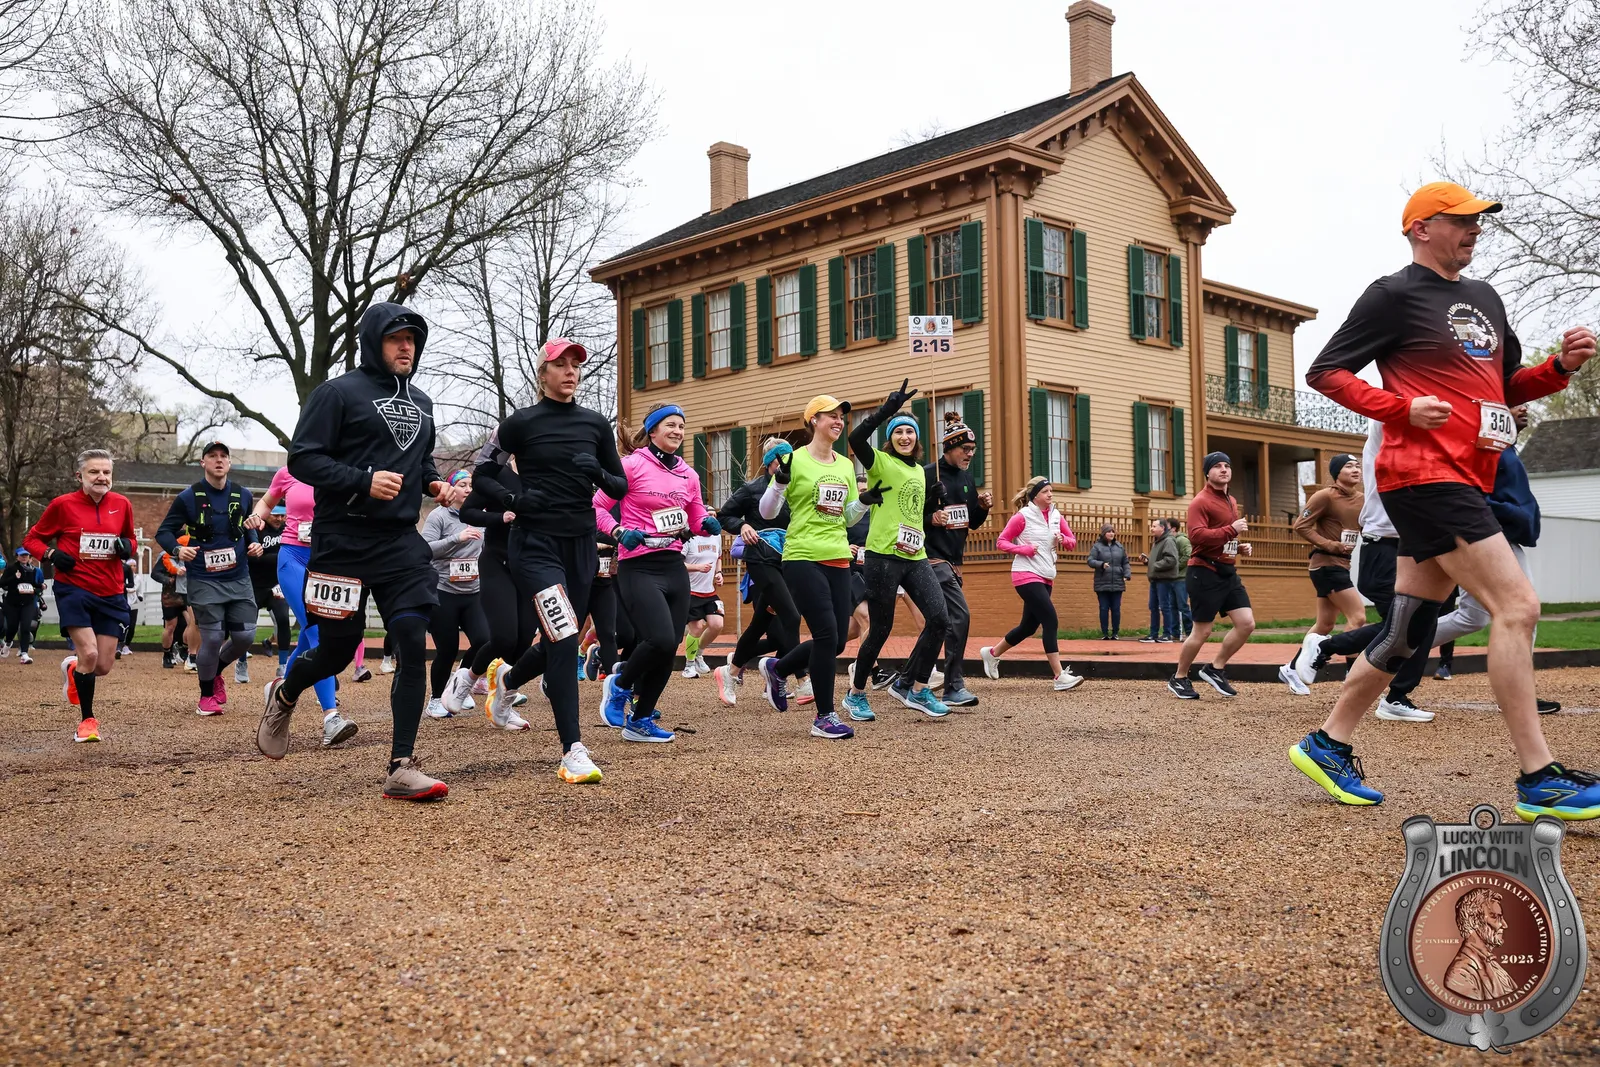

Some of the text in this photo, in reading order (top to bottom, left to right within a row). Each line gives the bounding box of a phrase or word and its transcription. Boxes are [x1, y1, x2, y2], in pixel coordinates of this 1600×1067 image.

[913, 339, 950, 352] 2:15
[381, 403, 418, 417] ELITE
[1491, 412, 1511, 434] 350
[825, 489, 843, 502] 952
[660, 512, 683, 527] 1129
[949, 509, 966, 520] 1044
[89, 539, 109, 549] 470
[903, 531, 920, 546] 1313
[209, 553, 231, 564] 1231
[459, 563, 470, 572] 48
[313, 583, 351, 603] 1081
[543, 597, 568, 632] 1183
